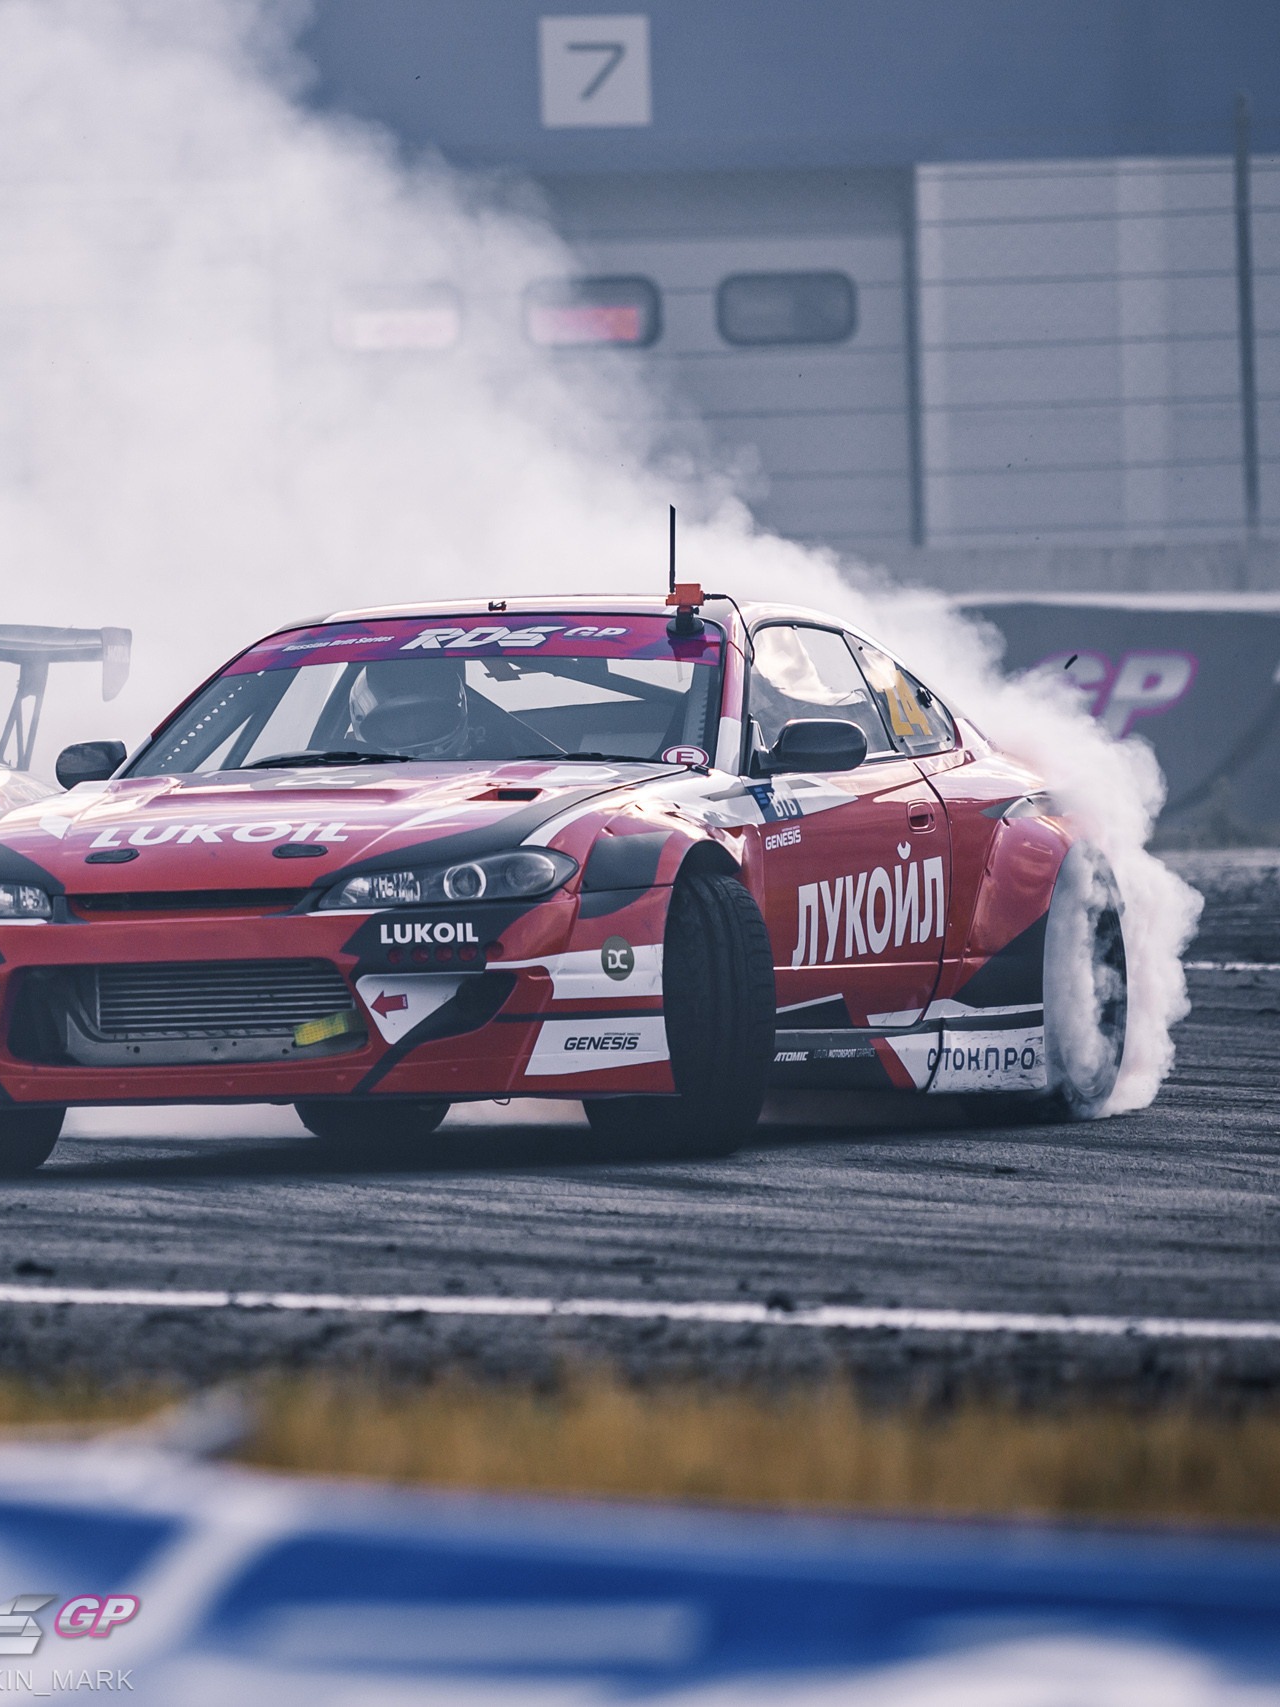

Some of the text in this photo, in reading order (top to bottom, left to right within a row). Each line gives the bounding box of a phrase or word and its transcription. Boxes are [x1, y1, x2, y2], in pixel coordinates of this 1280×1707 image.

[565, 42, 627, 101] 7
[399, 625, 627, 650] RDS GP
[89, 821, 350, 849] LUKOIL
[765, 829, 802, 851] GENESIS
[791, 841, 945, 970] ЛУКОЙЛ
[380, 921, 480, 945] LUKOIL
[563, 1036, 640, 1051] GENESIS
[773, 1051, 809, 1062] ATOMIC
[927, 1046, 1037, 1072] СТОКПРО
